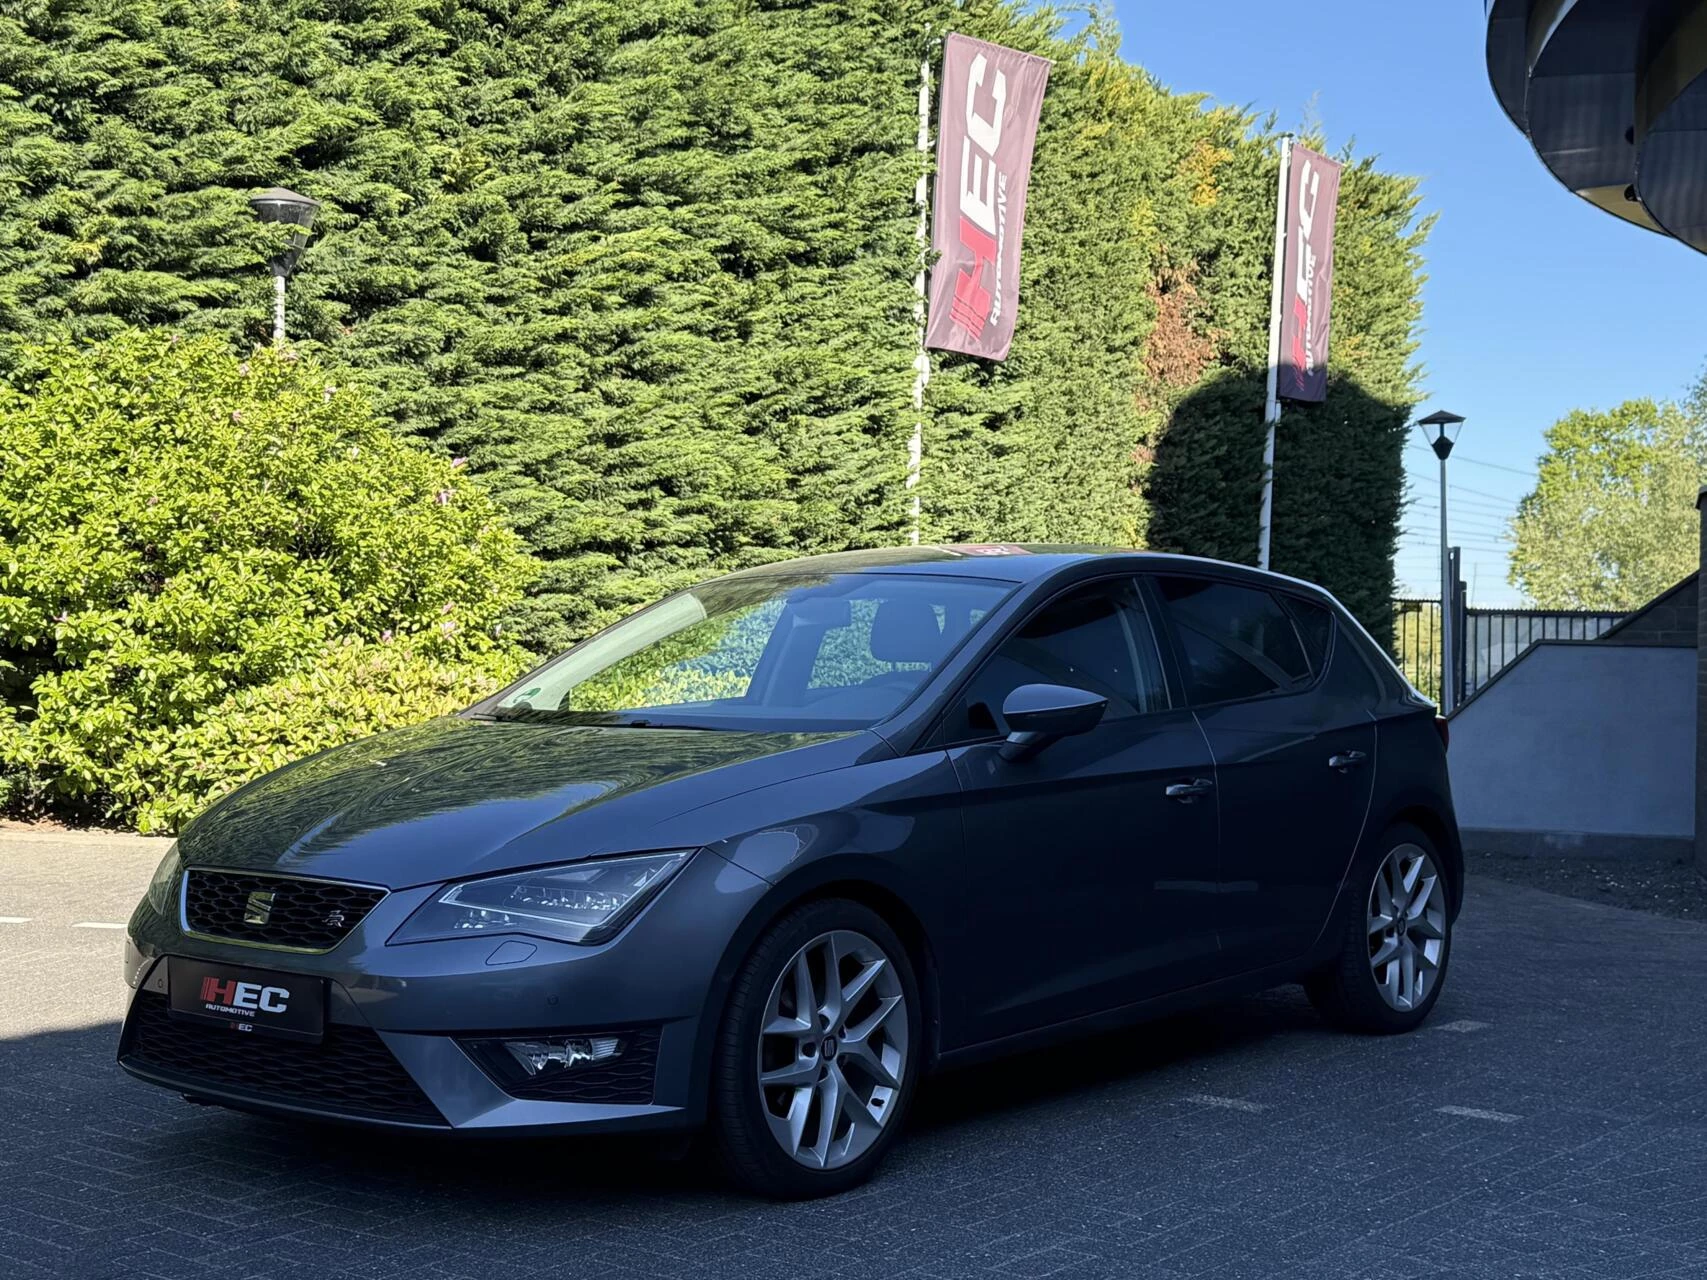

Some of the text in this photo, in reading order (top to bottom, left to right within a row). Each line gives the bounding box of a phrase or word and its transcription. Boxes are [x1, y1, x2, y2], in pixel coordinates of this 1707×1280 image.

[950, 52, 1007, 342] HEC
[988, 170, 1008, 327] AUTOMOTIVE
[201, 976, 290, 1013] HEC
[205, 1003, 255, 1017] AUTOMOTIVE
